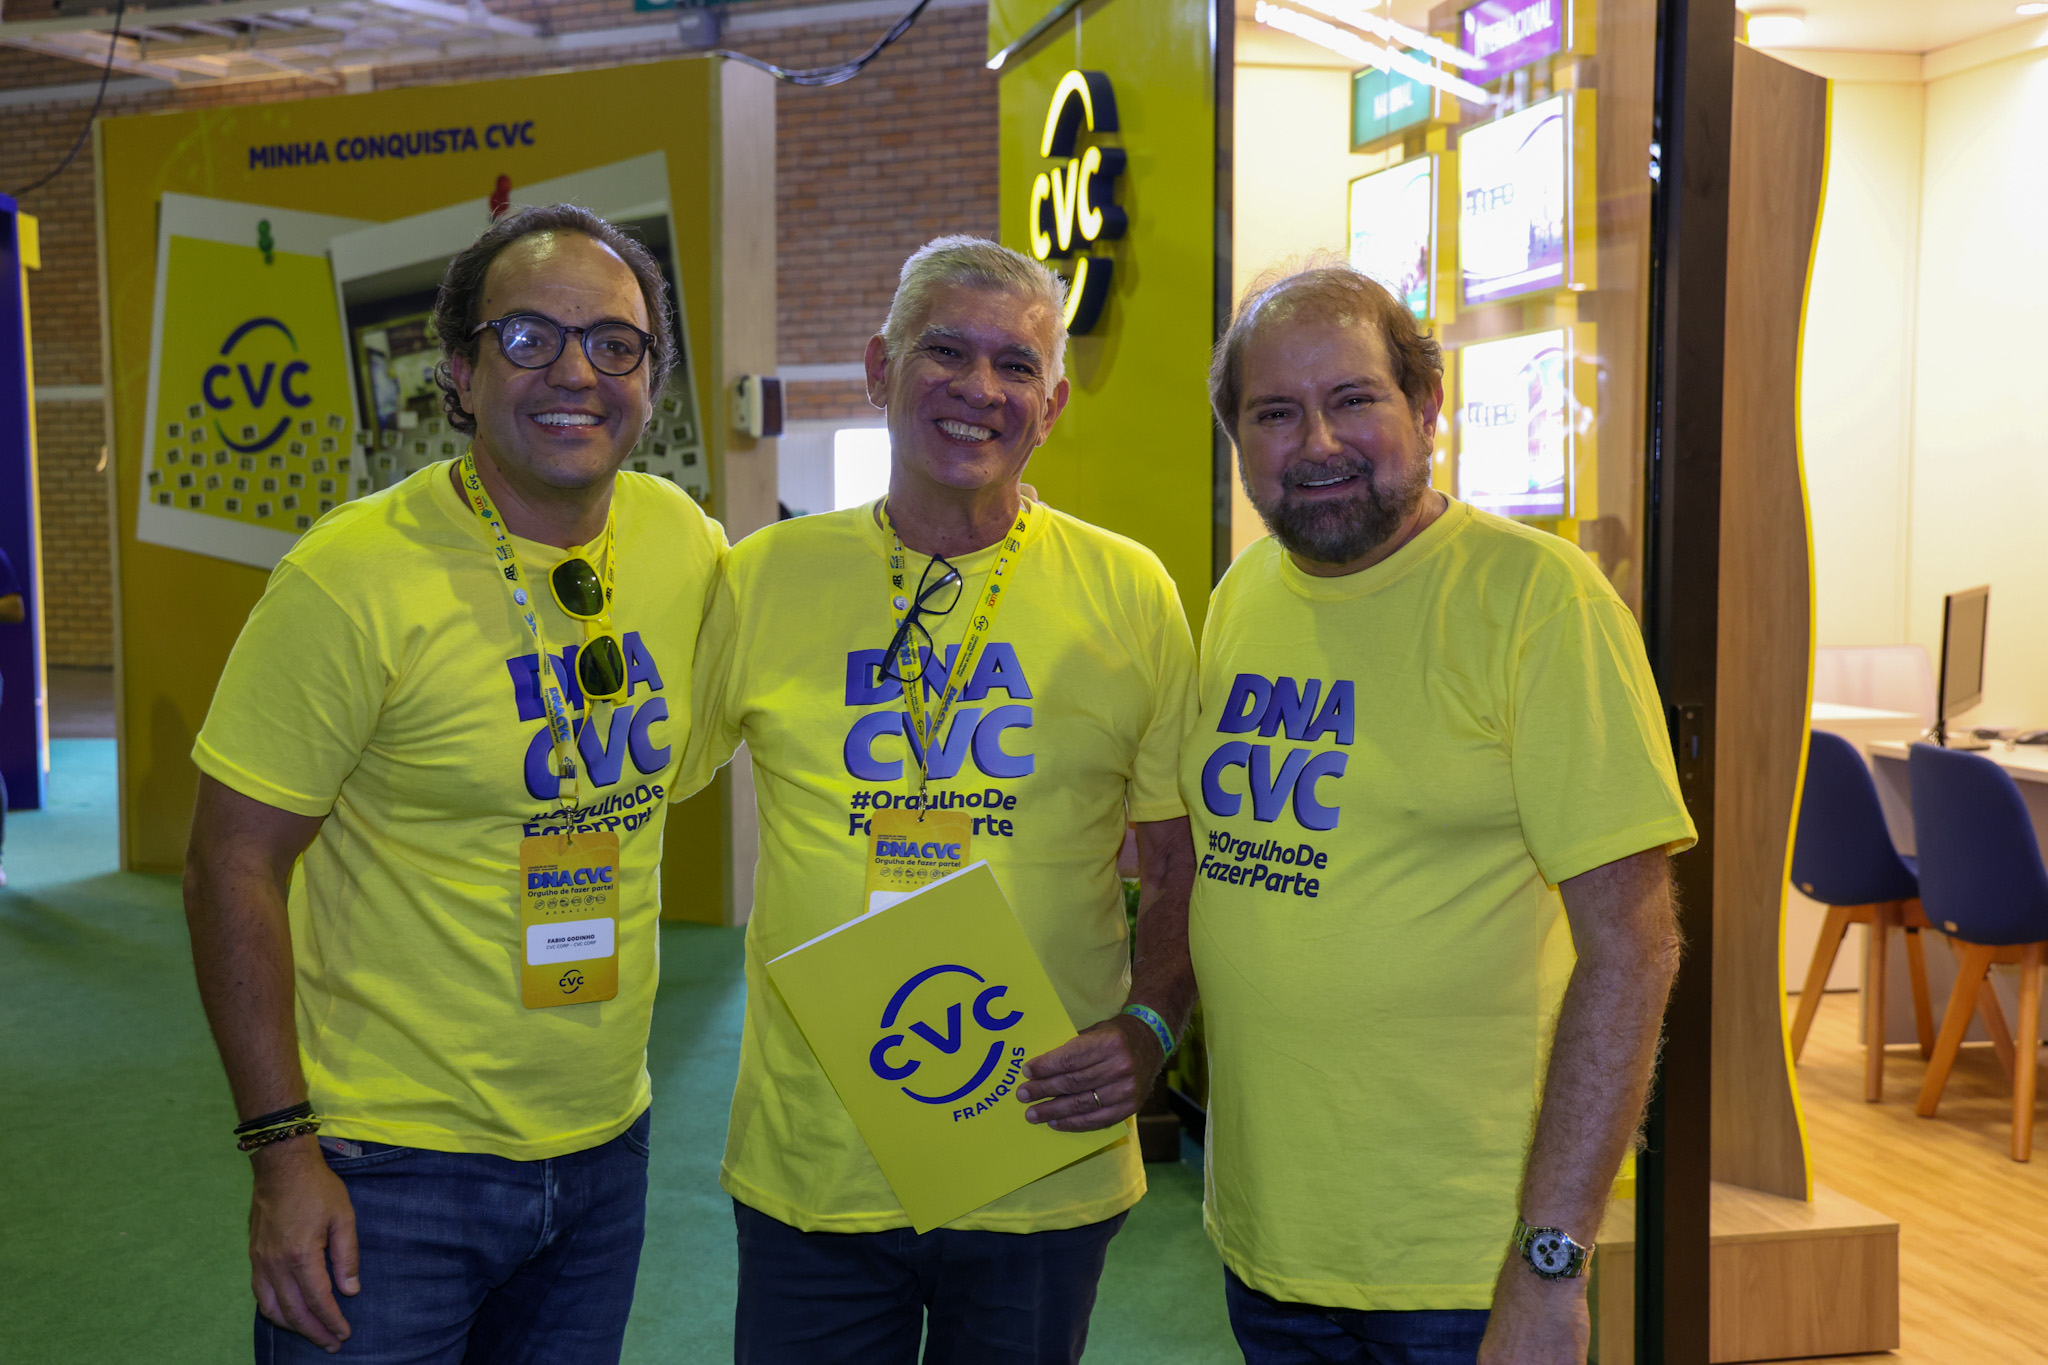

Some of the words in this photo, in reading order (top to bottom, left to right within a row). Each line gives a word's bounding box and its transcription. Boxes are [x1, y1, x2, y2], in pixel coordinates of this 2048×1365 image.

[249, 141, 330, 170] MINHA
[335, 127, 478, 162] CONQUISTA
[485, 121, 535, 149] CVC
[1029, 145, 1103, 261] CVC
[202, 359, 313, 410] CVC
[845, 642, 1033, 706] DNA
[1216, 673, 1355, 745] DNA
[524, 697, 671, 800] CVC
[843, 704, 1035, 782] CVC
[1201, 741, 1349, 831] CVC
[874, 857, 905, 866] Orgulho
[876, 841, 921, 858] DNA
[921, 842, 962, 860] CVC
[1208, 830, 1328, 870] #OrgulhoDe
[527, 889, 558, 898] Orgulho
[591, 884, 614, 892] parte!
[528, 870, 574, 890] DNA
[573, 866, 613, 885] CVC
[1199, 854, 1320, 898] FazerParte
[567, 934, 595, 942] GODINHO
[559, 976, 585, 987] CVC
[869, 985, 1024, 1081] CVC
[952, 1047, 1026, 1122] FRANQUIAS
